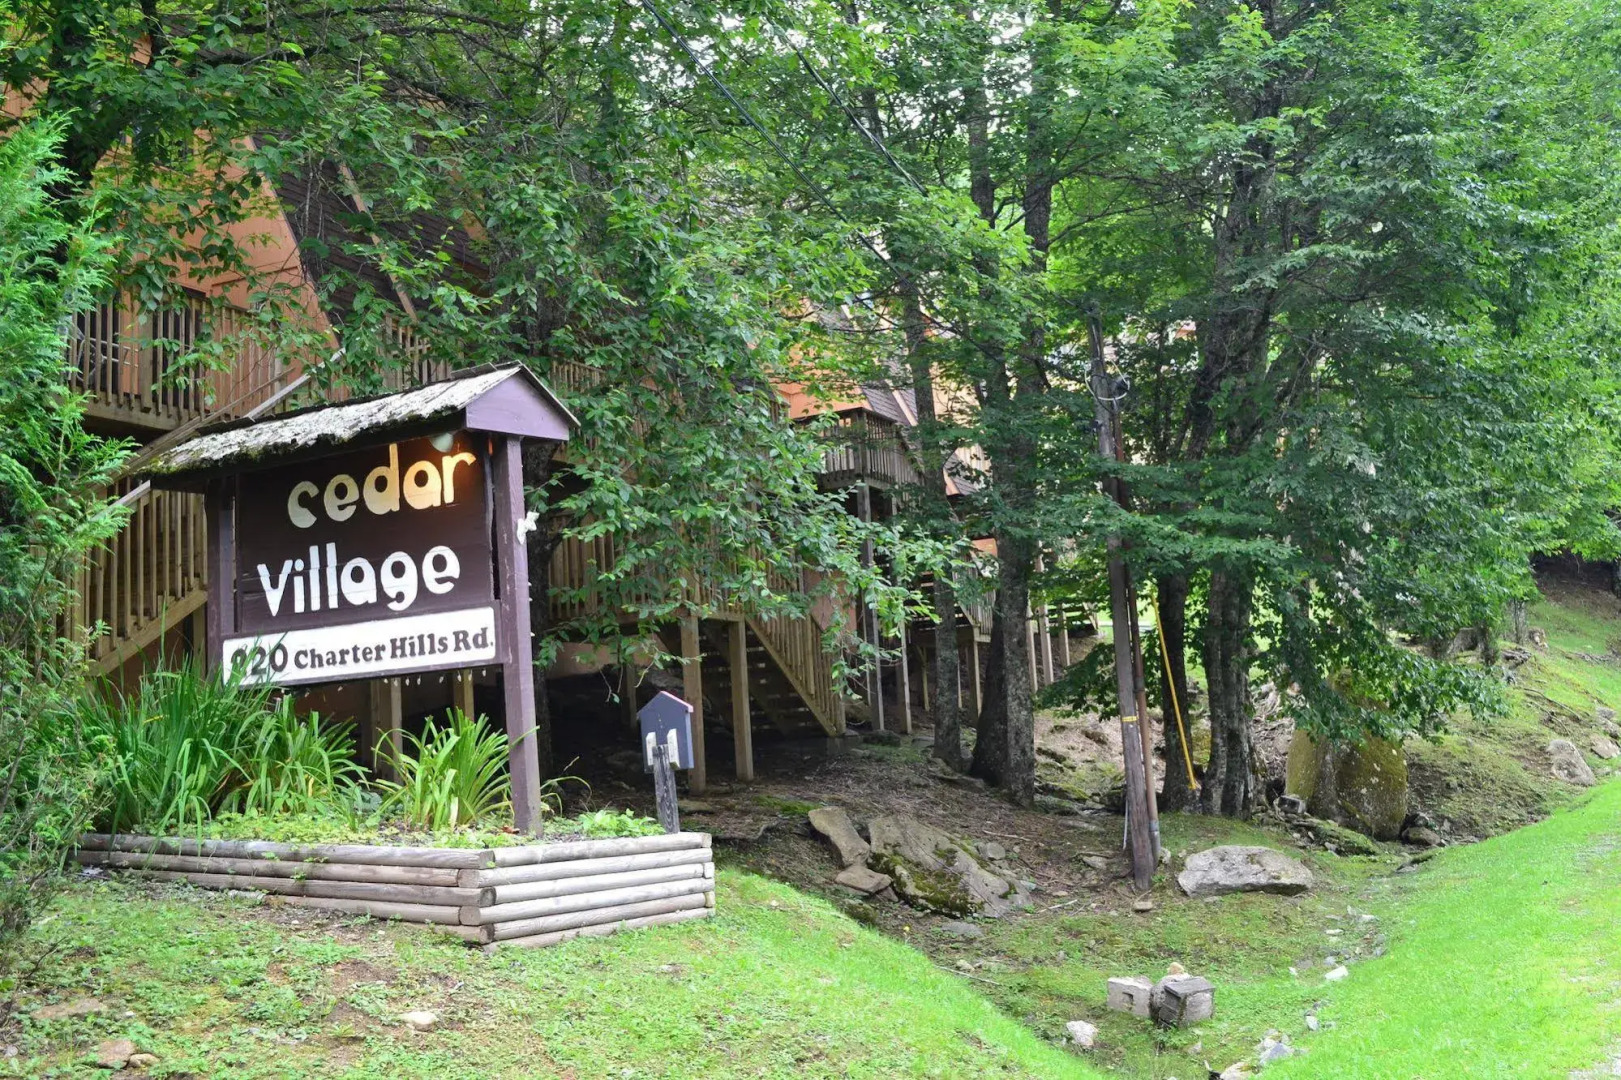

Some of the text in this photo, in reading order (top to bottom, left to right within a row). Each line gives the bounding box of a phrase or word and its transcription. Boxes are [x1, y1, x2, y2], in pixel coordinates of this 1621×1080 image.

[287, 443, 477, 528] cedar
[294, 643, 386, 670] Charter
[389, 633, 449, 659] Hills
[452, 626, 494, 652] Rd.
